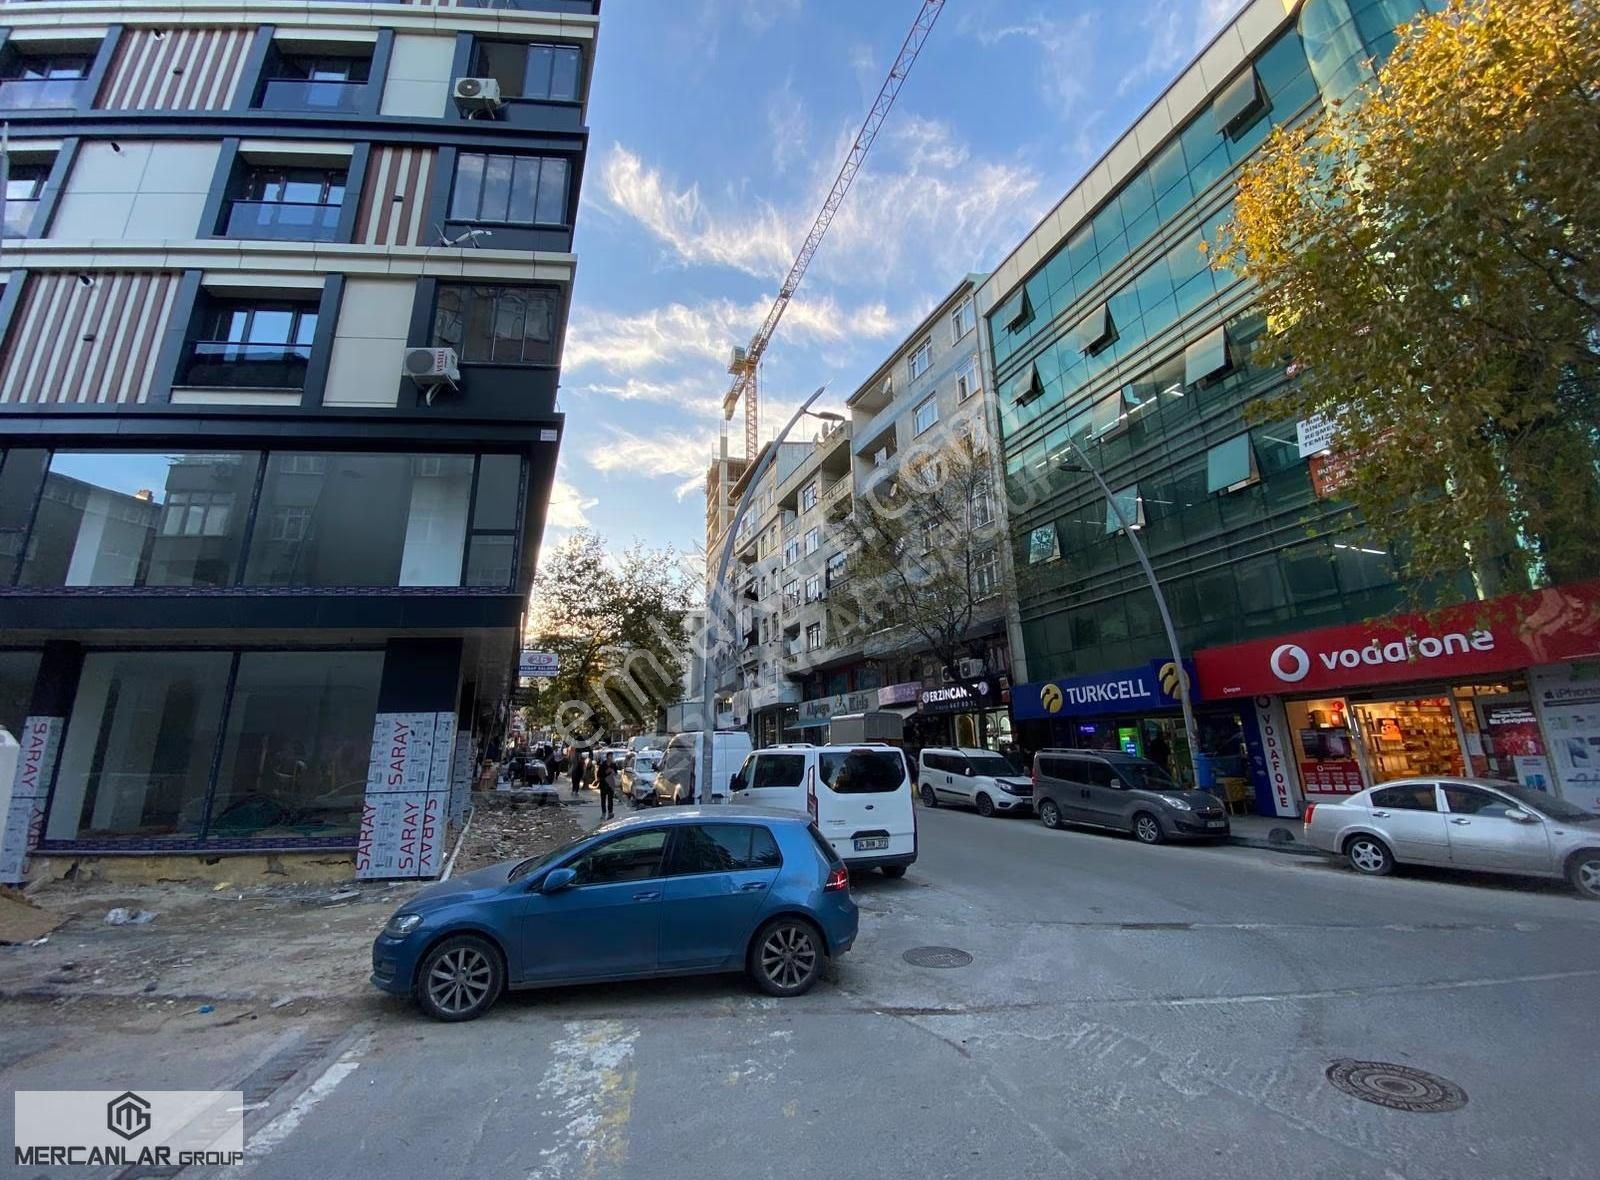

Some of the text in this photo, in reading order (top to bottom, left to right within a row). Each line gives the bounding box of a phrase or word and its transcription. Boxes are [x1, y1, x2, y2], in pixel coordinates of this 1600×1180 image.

[1066, 679, 1151, 705] TURKCELL
[21, 722, 48, 788] SARAY
[388, 721, 410, 786] SARAY
[1263, 714, 1288, 808] VODAFONE
[355, 801, 377, 871] SARAY
[398, 802, 420, 870] SARAY
[419, 799, 438, 866] SARAY
